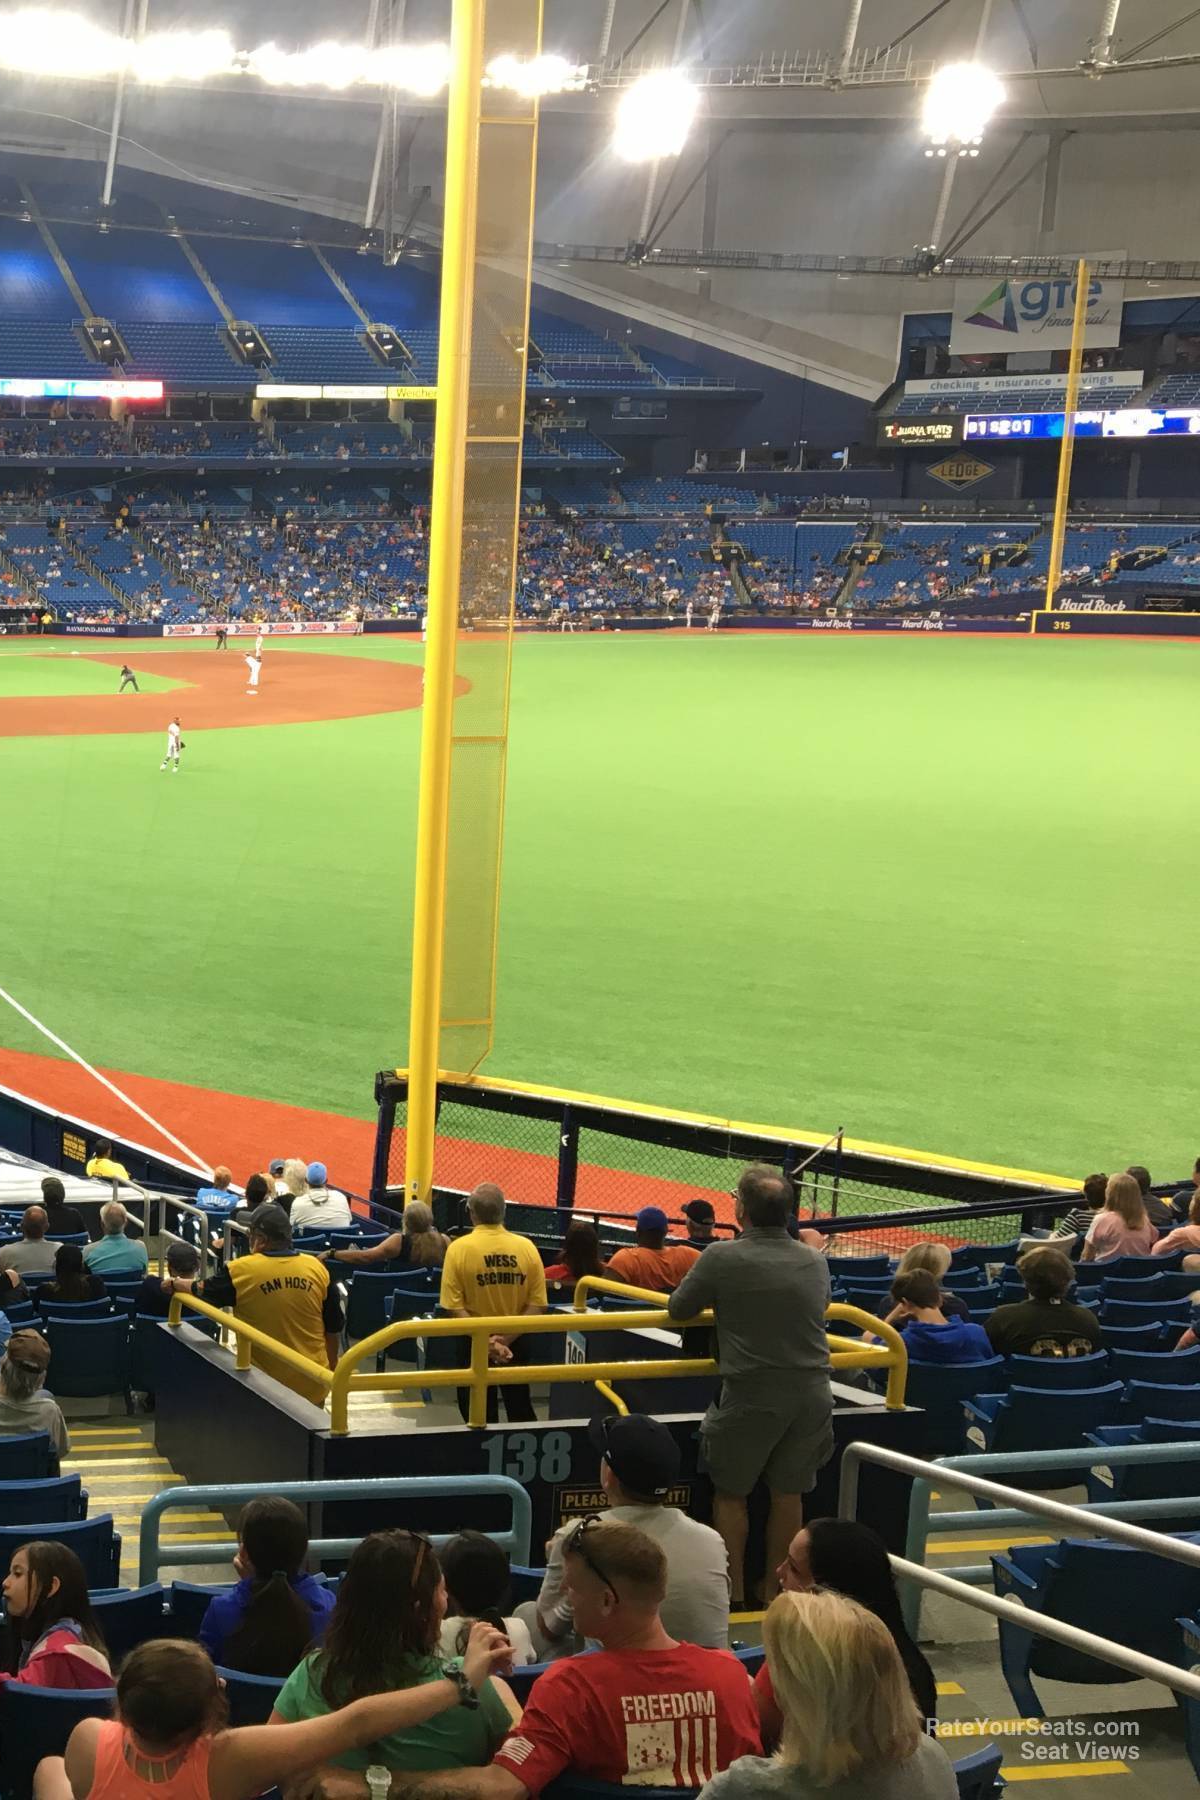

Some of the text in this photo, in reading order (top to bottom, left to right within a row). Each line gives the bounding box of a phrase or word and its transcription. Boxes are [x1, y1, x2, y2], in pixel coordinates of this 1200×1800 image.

[1031, 310, 1110, 333] finaial
[929, 379, 980, 391] checking
[994, 377, 1052, 388] insurance
[926, 424, 953, 435] FLATS
[940, 463, 980, 478] LEDGE
[1059, 598, 1126, 612] Hard Rock
[812, 619, 852, 629] Hard Rock
[902, 620, 944, 630] Hard Rock
[1053, 621, 1071, 630] 315
[483, 1254, 518, 1268] WESS
[260, 1276, 313, 1295] FAN HOST
[476, 1271, 527, 1287] SECURITY
[481, 1431, 572, 1483] 138
[565, 1493, 610, 1507] PLEAS
[621, 1690, 716, 1721] FREEDOM
